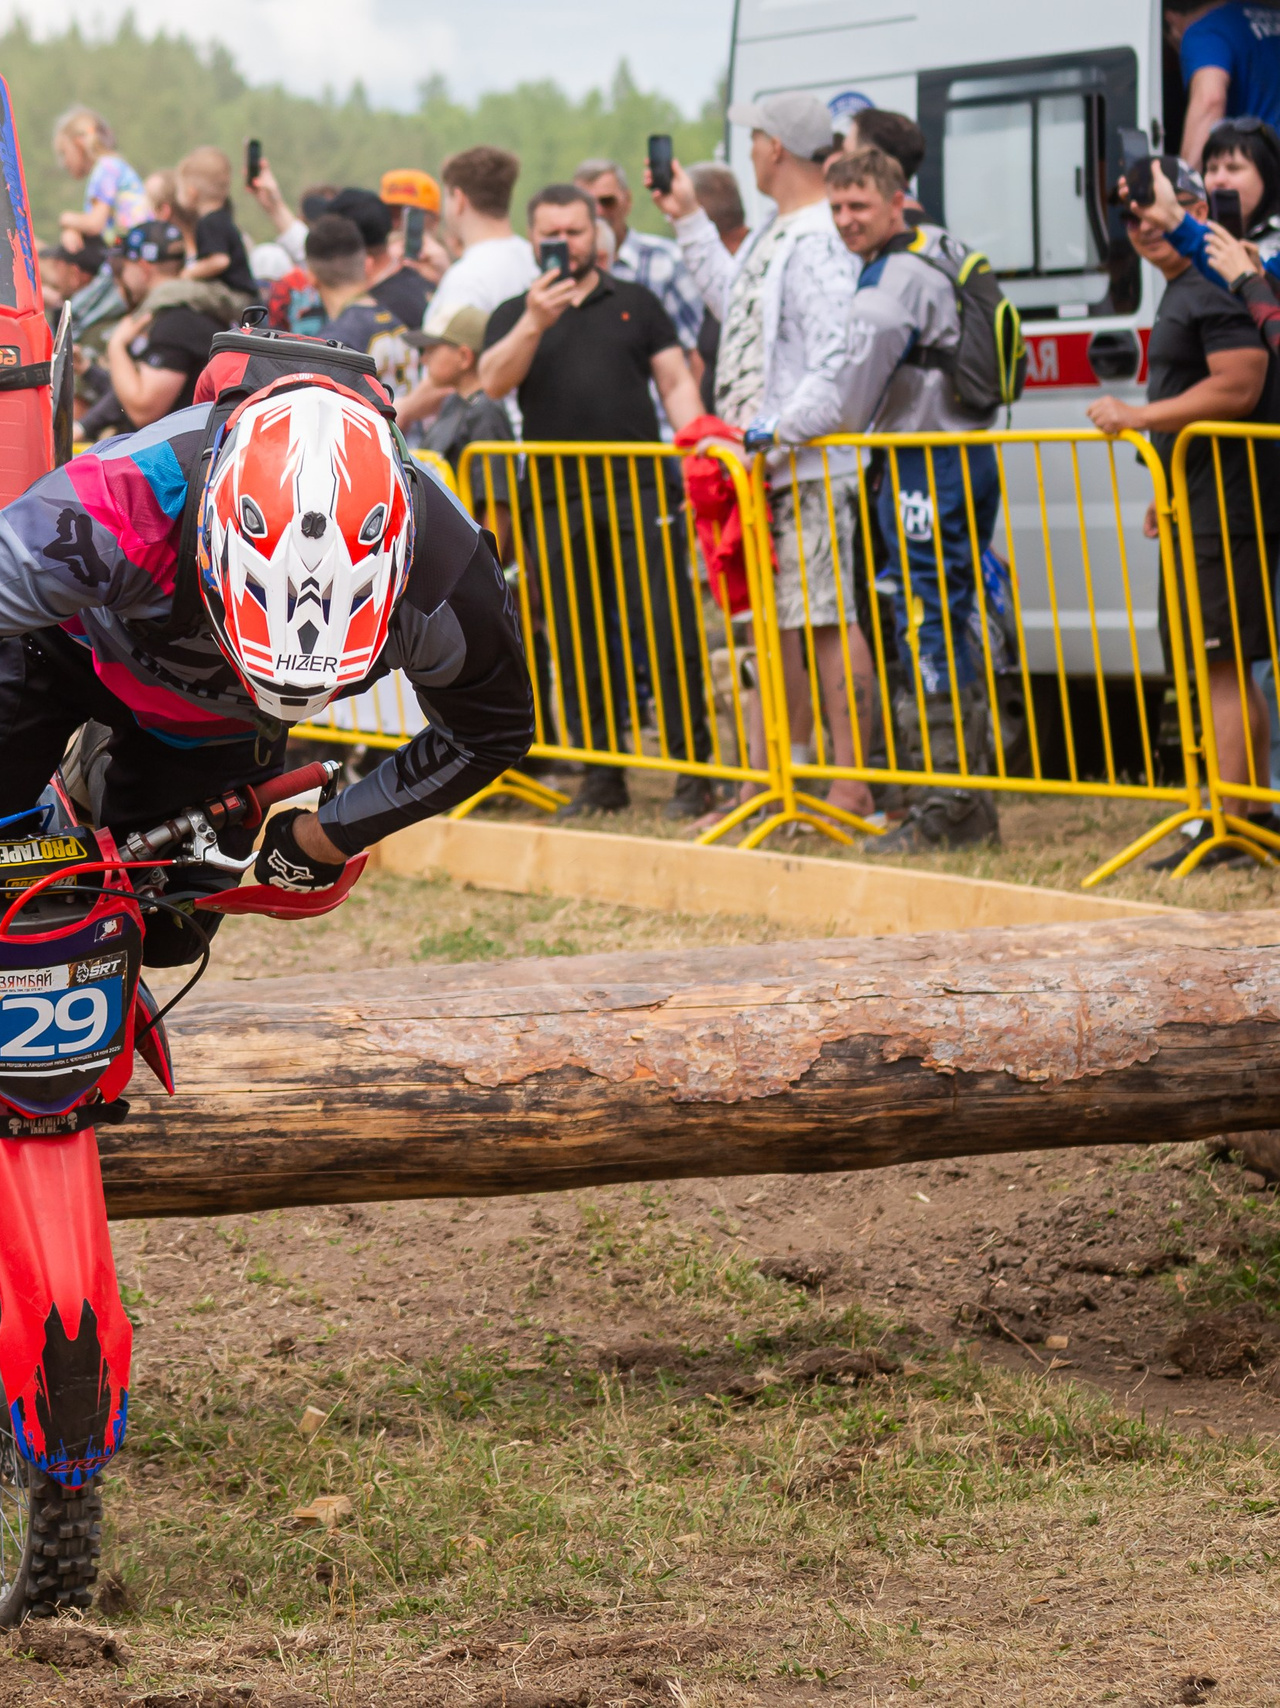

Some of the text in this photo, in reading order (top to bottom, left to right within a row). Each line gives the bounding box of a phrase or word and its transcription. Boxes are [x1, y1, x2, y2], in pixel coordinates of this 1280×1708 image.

[275, 653, 338, 674] HIZER
[88, 958, 122, 977] SRT
[0, 987, 108, 1058] 29
